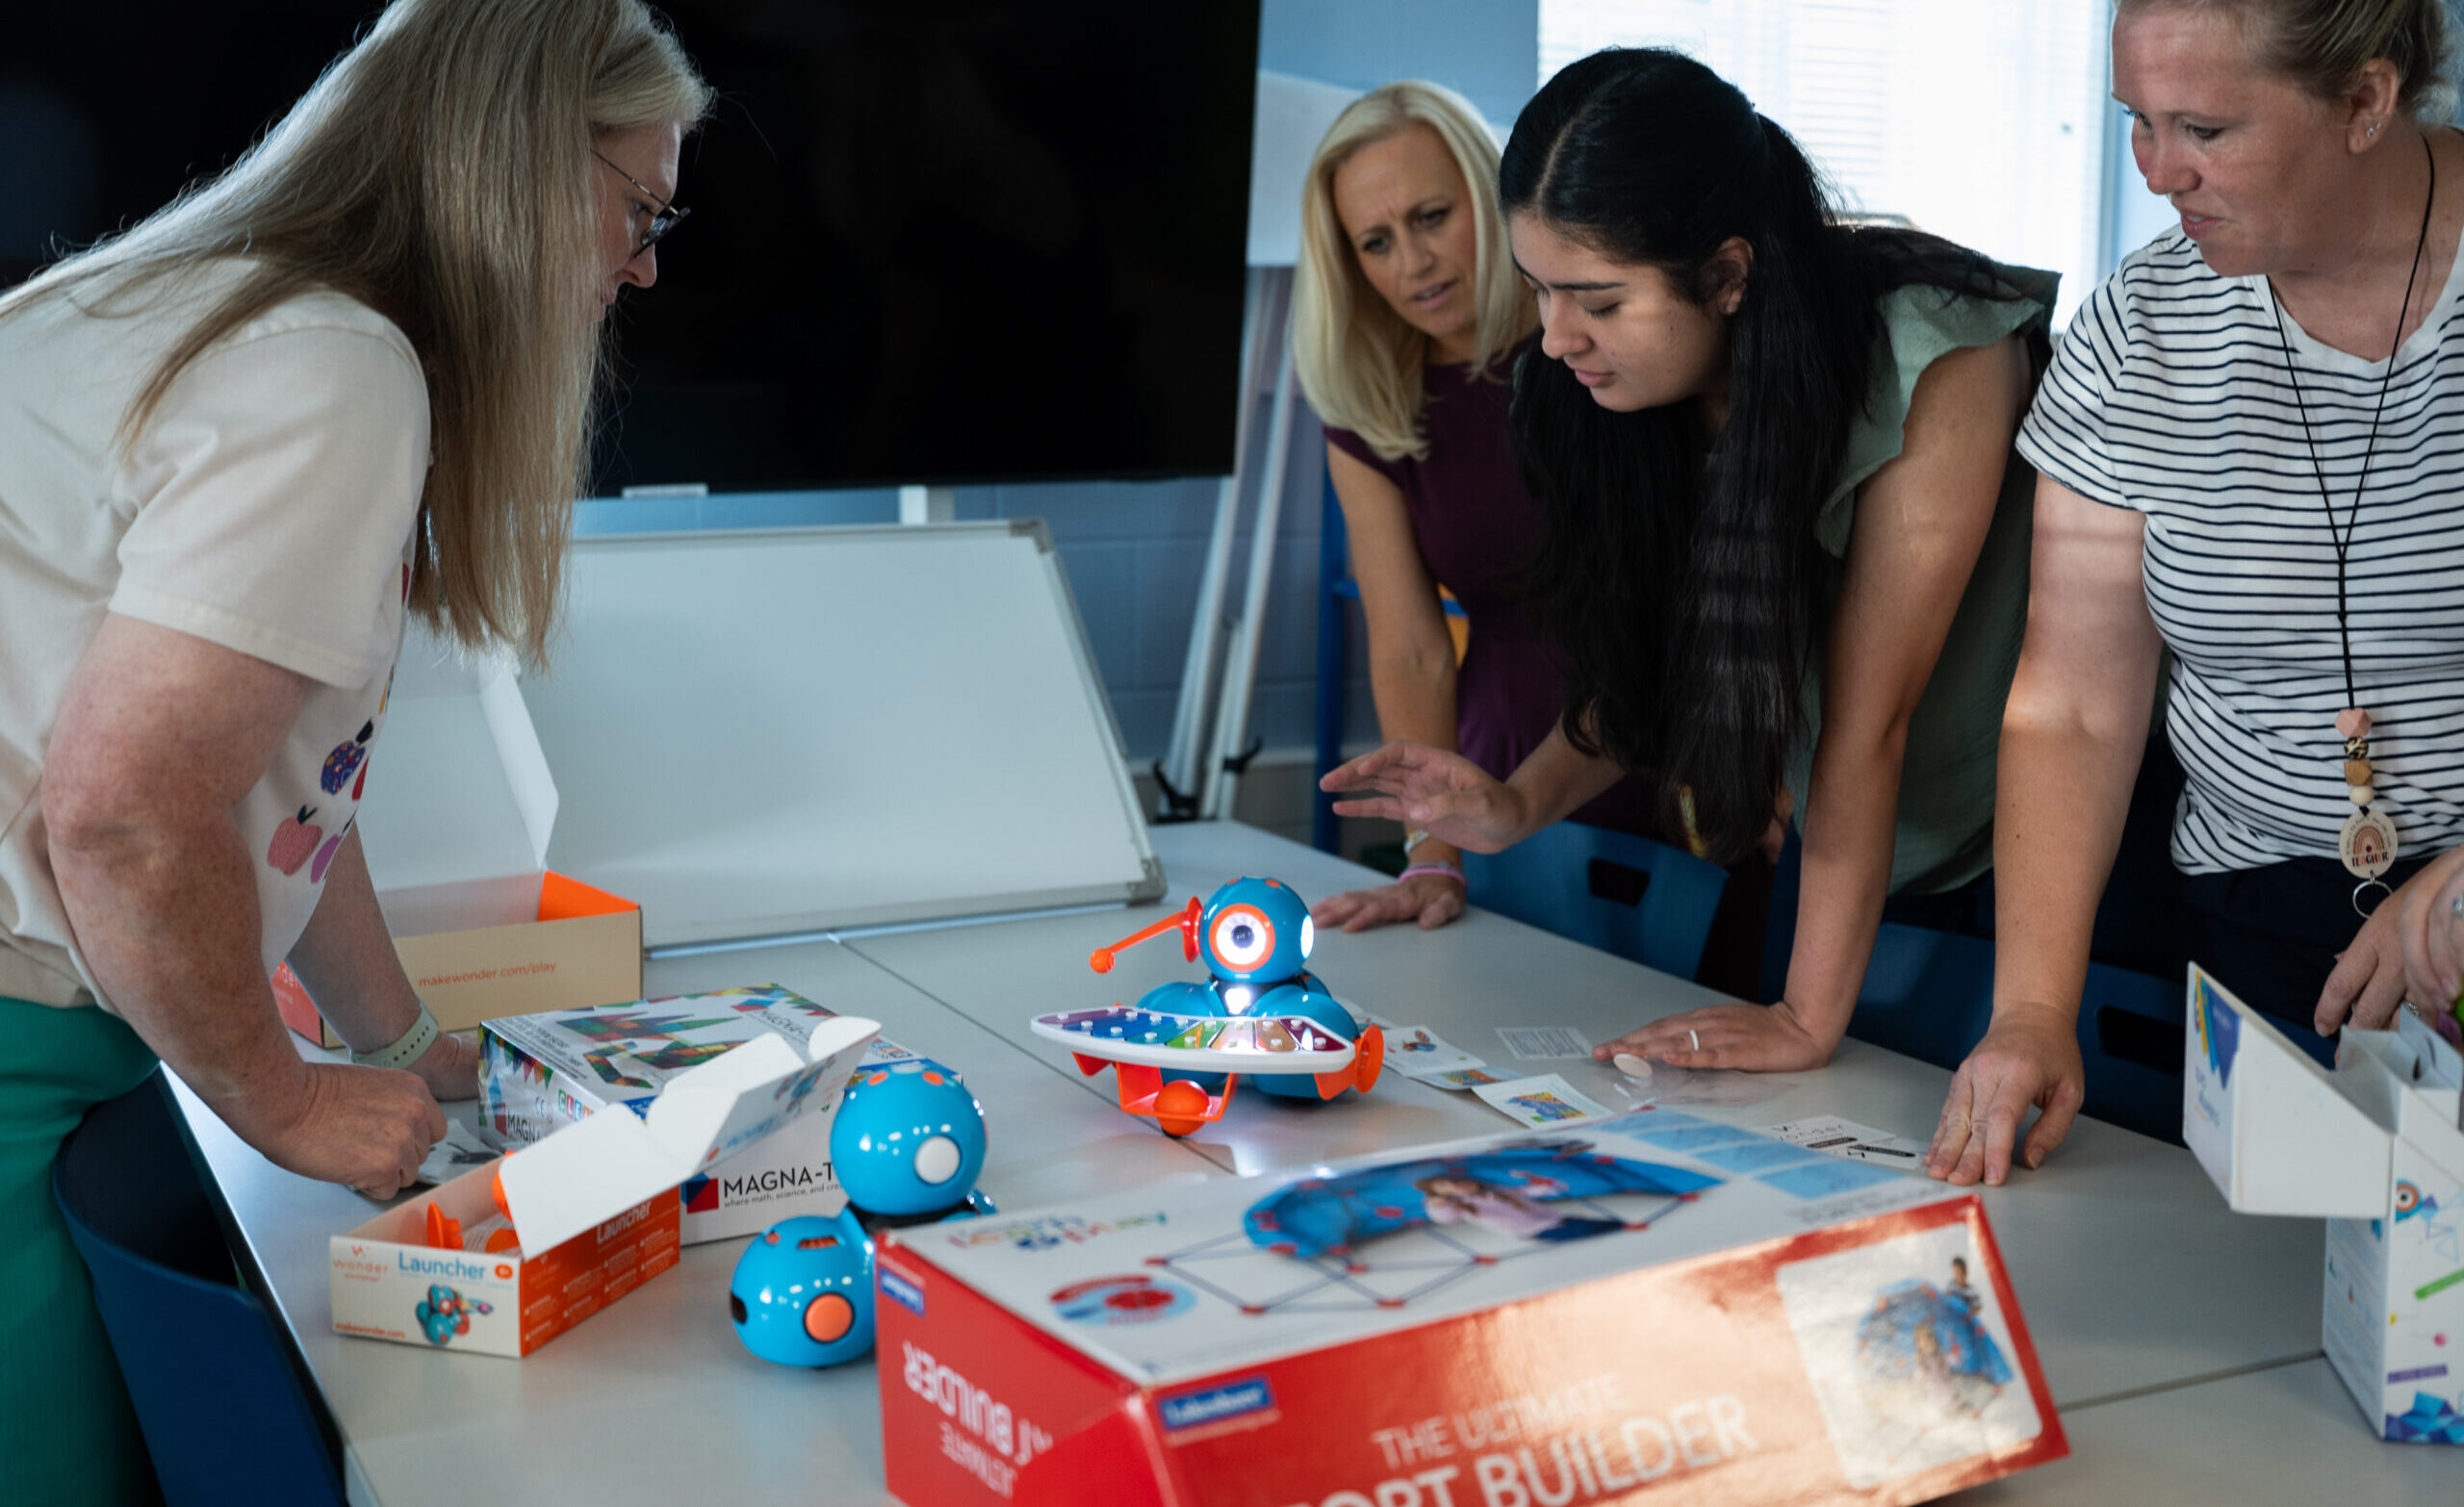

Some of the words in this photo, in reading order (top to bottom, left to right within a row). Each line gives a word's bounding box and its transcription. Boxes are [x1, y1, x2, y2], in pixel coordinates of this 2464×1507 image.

[418, 962, 556, 988] makewonder.com/play
[724, 1197, 749, 1208] where
[751, 1194, 774, 1204] math,
[776, 1188, 808, 1200] science,
[809, 1184, 824, 1193] and
[597, 1202, 652, 1244] Launcher
[332, 1258, 388, 1273] wonder
[398, 1250, 485, 1280] Launcher
[903, 1341, 1014, 1456] BUILDER
[1371, 1415, 1456, 1469] THE
[1452, 1371, 1629, 1450] ULTIMATE
[1474, 1392, 1759, 1507] BUILDER
